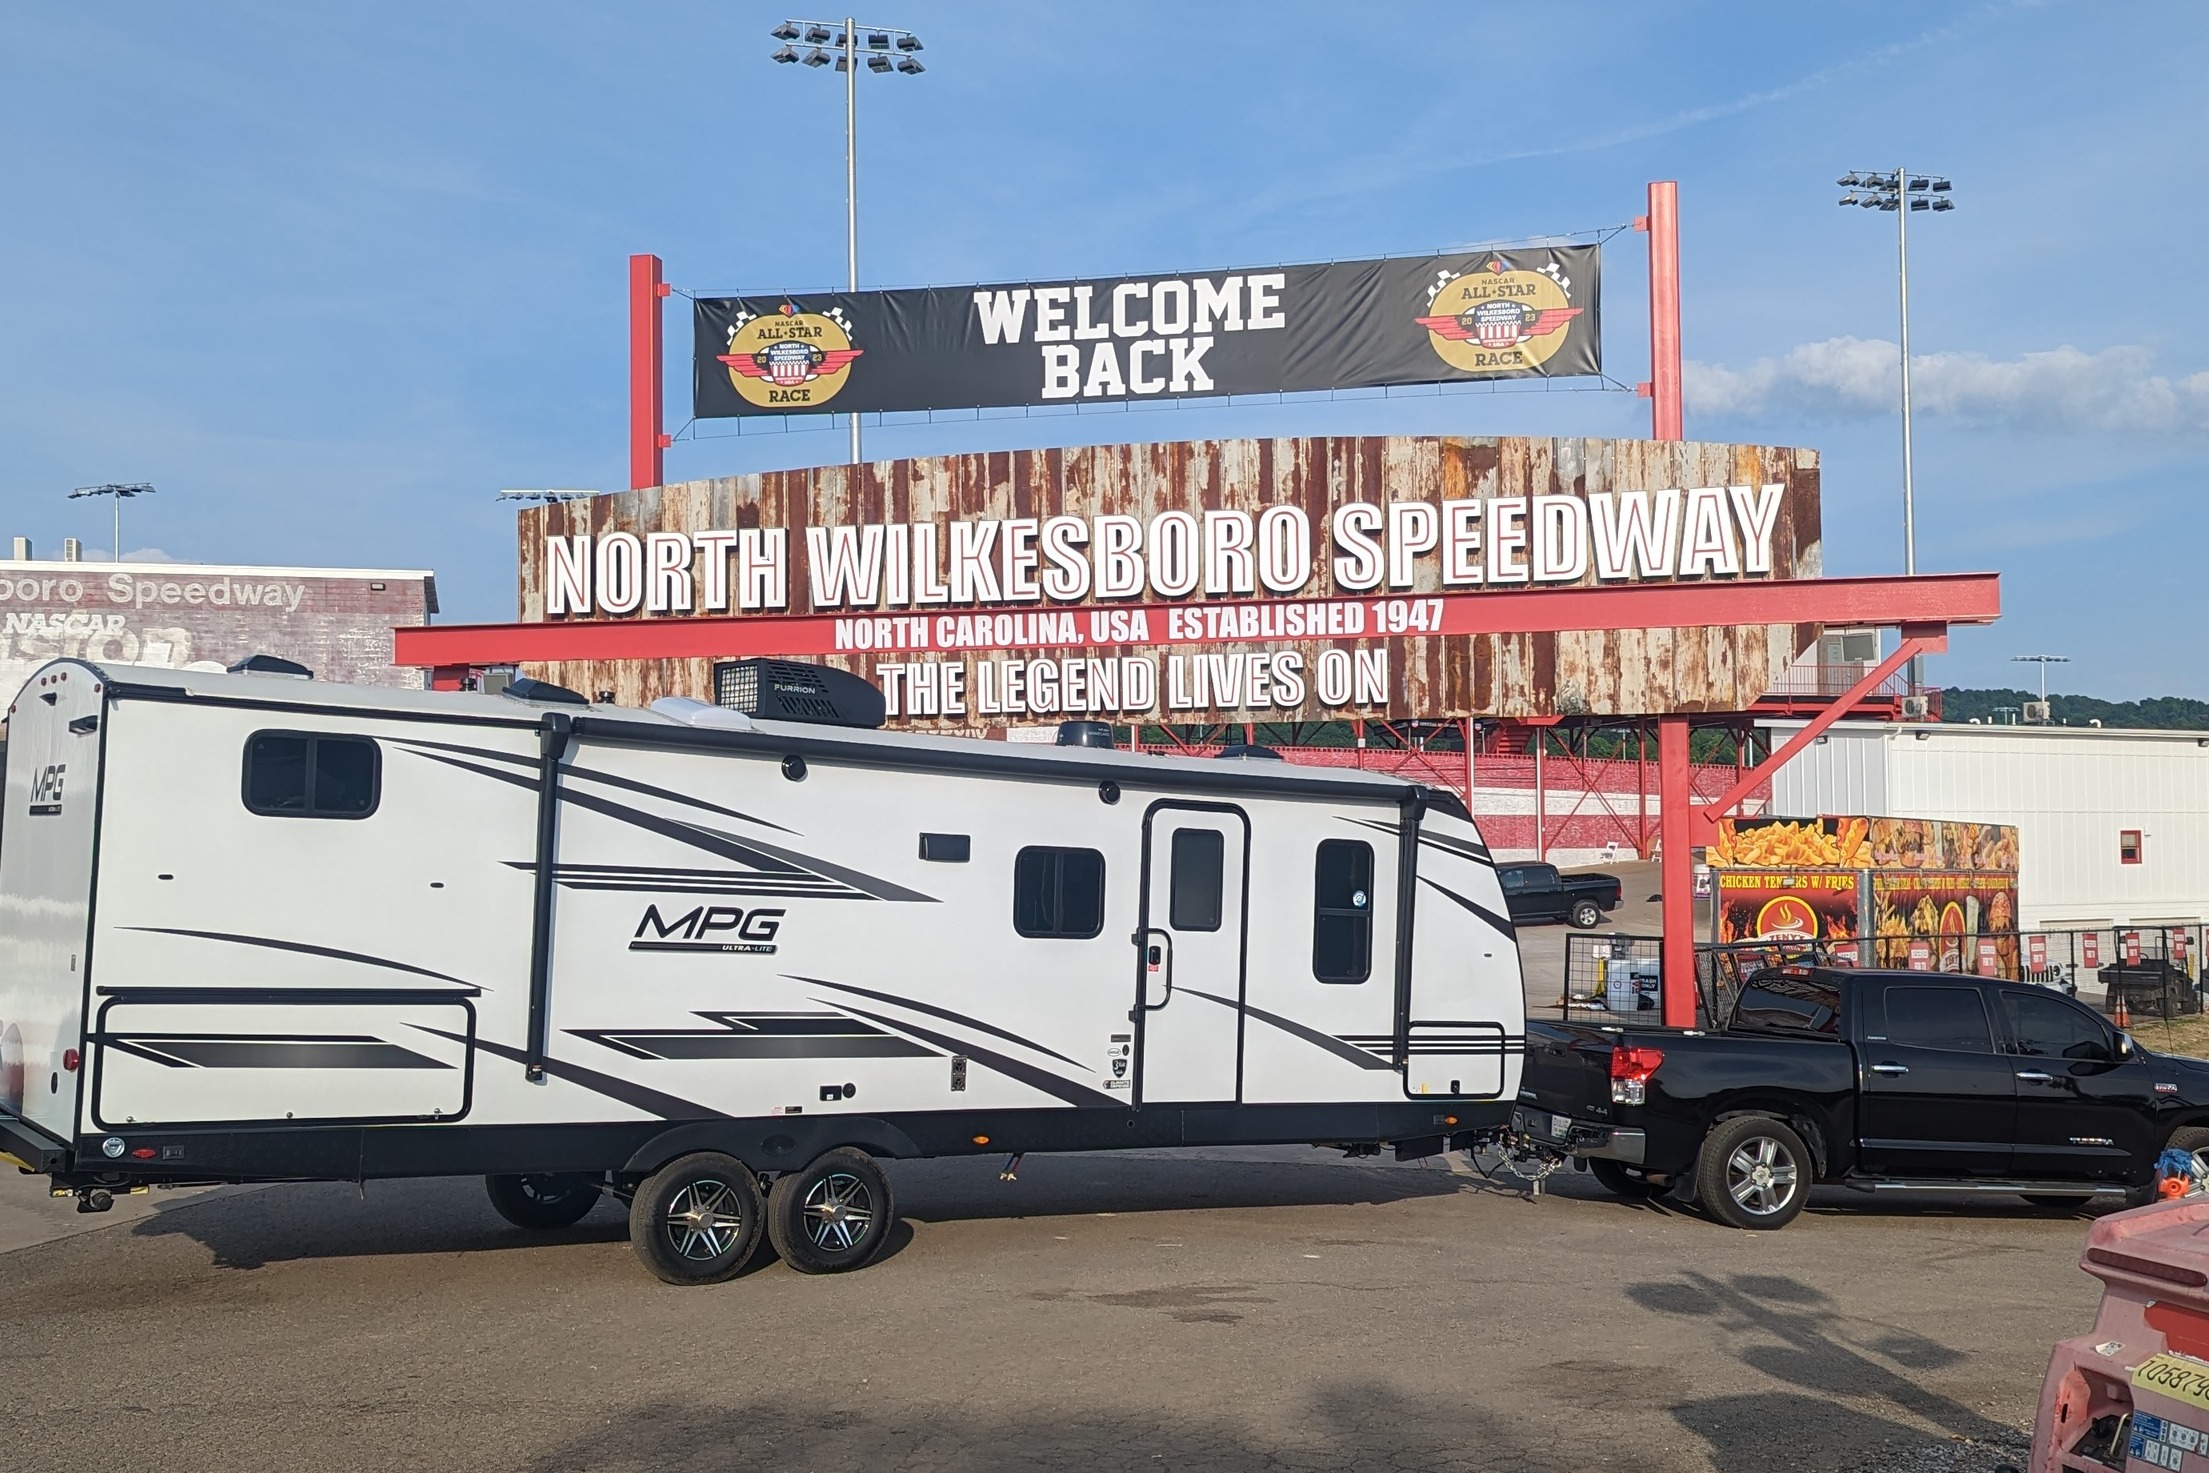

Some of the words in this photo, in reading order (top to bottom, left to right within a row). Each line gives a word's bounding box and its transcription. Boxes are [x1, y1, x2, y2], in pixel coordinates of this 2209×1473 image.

[1481, 277, 1515, 286] NASCAR
[973, 273, 1286, 345] WELCOME
[1461, 316, 1473, 325] 20
[757, 355, 767, 364] 20
[812, 353, 823, 362] 23
[1042, 336, 1214, 399] BACK
[1474, 351, 1524, 367] RACE
[769, 389, 811, 403] RACE
[546, 527, 789, 616] NORTH
[806, 502, 1312, 608] WILKESBORO
[1333, 482, 1784, 591] SPEEDWAY
[107, 573, 306, 613] Speedway
[3, 612, 126, 636] NASCAR
[834, 616, 930, 650] NORTH
[935, 610, 1087, 648] CAROLINA,
[1091, 608, 1150, 643] USA
[1168, 600, 1366, 640] ESTABLISHED
[1371, 597, 1445, 634] 1947
[774, 683, 816, 695] FURRION
[876, 661, 966, 717] THE
[977, 656, 1157, 715] LEGEND
[1168, 650, 1306, 712] LIVES
[1317, 648, 1390, 707] ON
[30, 764, 67, 803] MPG
[1720, 875, 1762, 889] CHICKEN
[1763, 875, 1808, 889] TENRS
[1811, 875, 1823, 889] W/
[1825, 875, 1855, 890] FRIES
[634, 903, 787, 942] MPG
[722, 944, 773, 953] ULTRA-LITE
